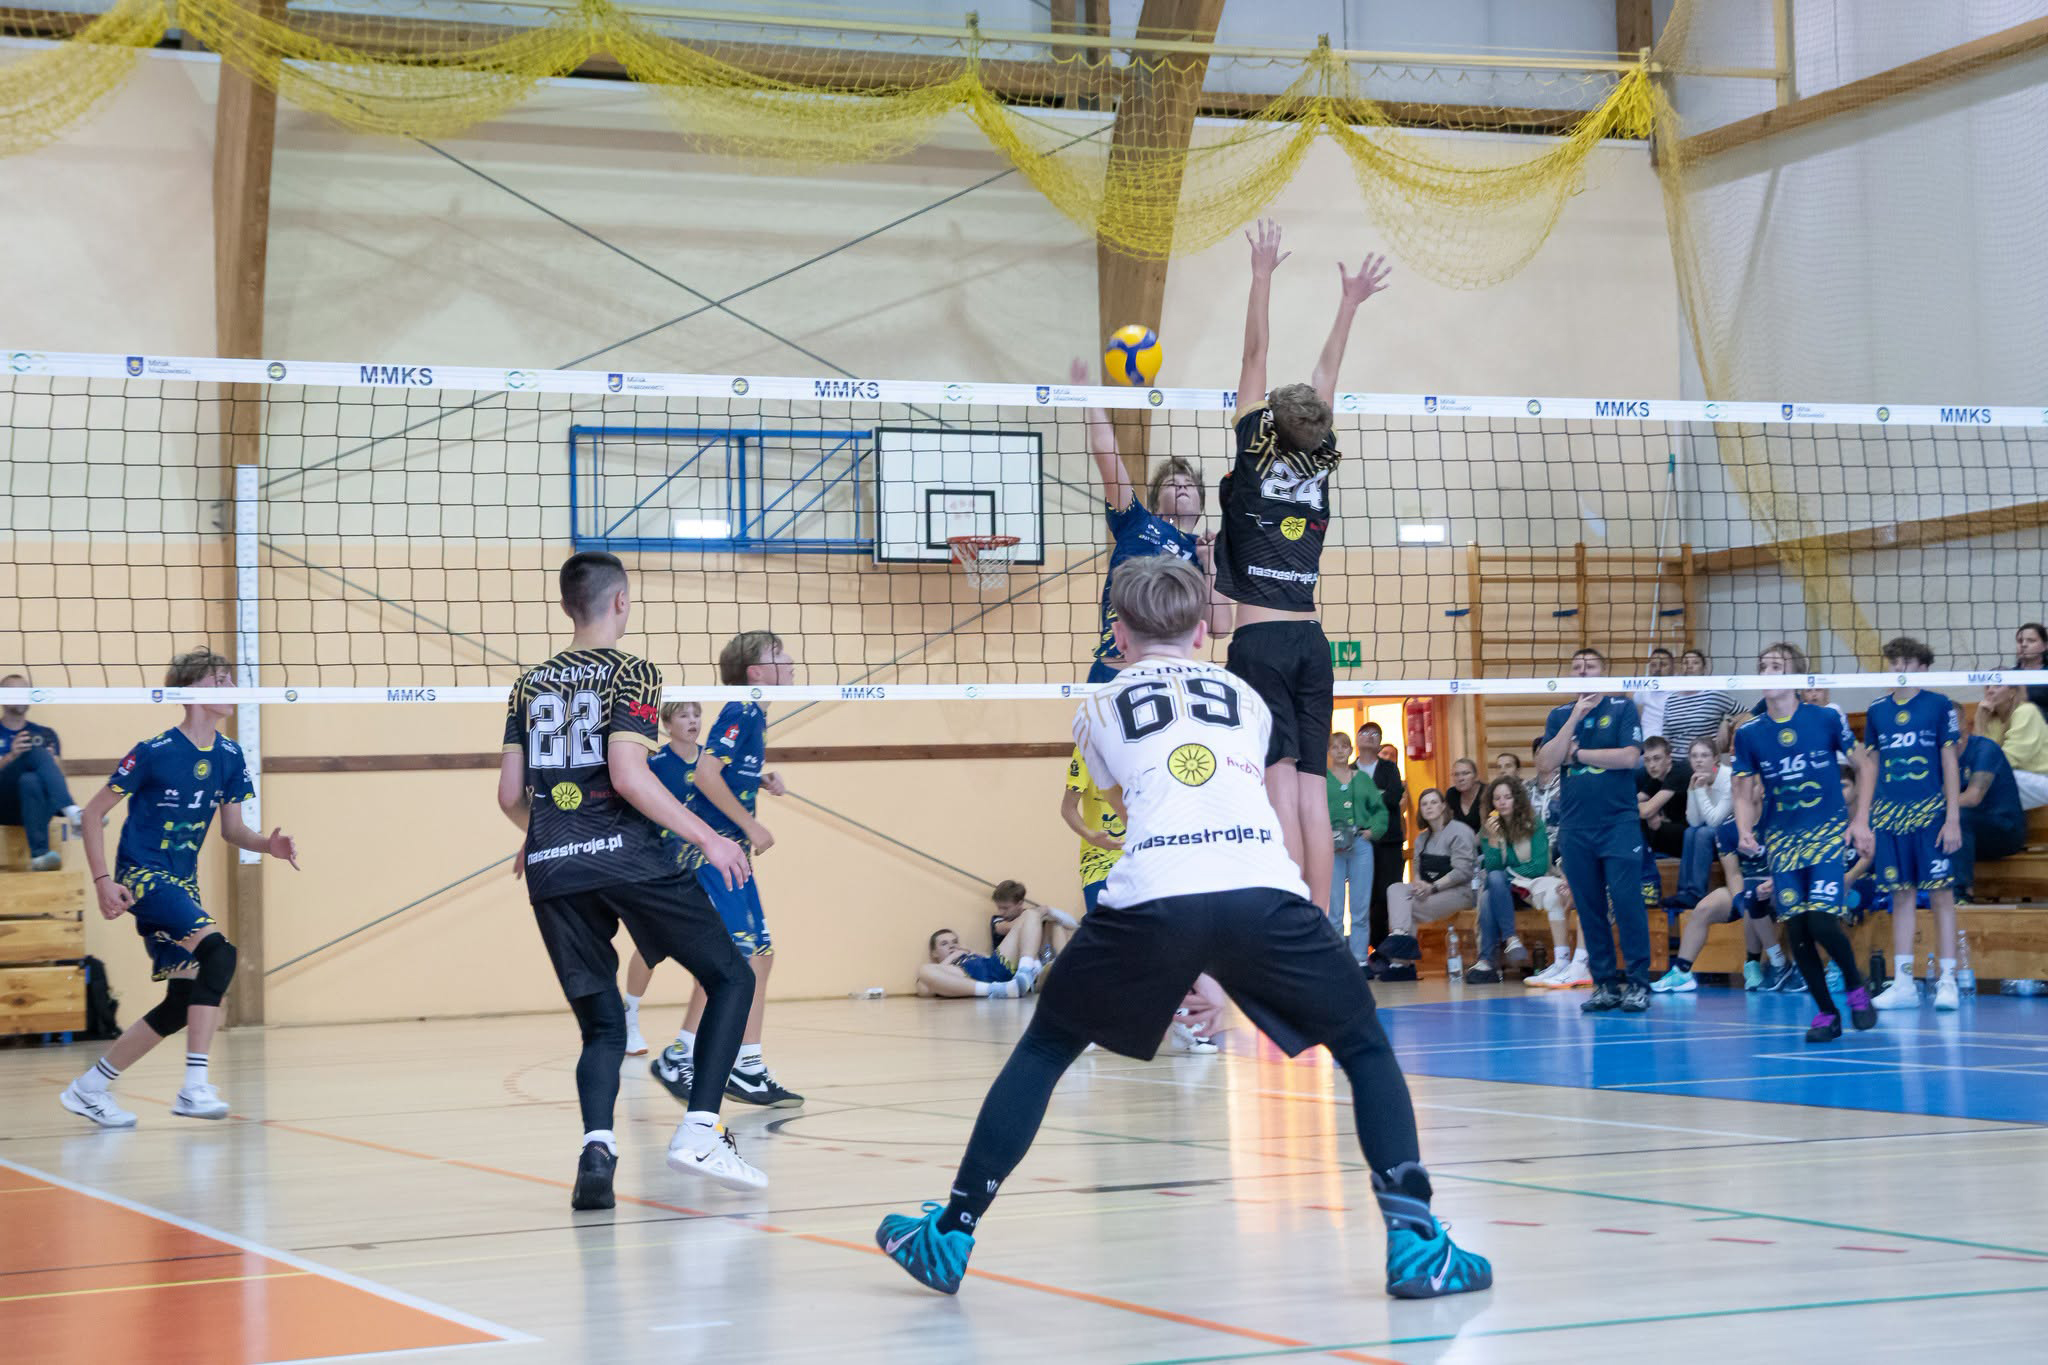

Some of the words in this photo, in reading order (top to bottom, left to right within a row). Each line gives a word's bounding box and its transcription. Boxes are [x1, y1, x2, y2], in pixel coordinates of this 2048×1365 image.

[360, 365, 433, 386] MMKS
[815, 380, 880, 399] MMKS
[1595, 401, 1650, 417] MMKS
[1941, 408, 1992, 424] MMKS
[1260, 459, 1329, 512] 24
[387, 688, 436, 702] MMKS
[841, 686, 886, 699] MMKS
[1112, 677, 1244, 743] 69
[528, 689, 606, 769] 22
[1889, 731, 1917, 748] 20
[1778, 753, 1806, 774] 16
[187, 789, 205, 809] 1
[527, 833, 624, 866] naszestroje.pl
[1809, 879, 1839, 896] 16
